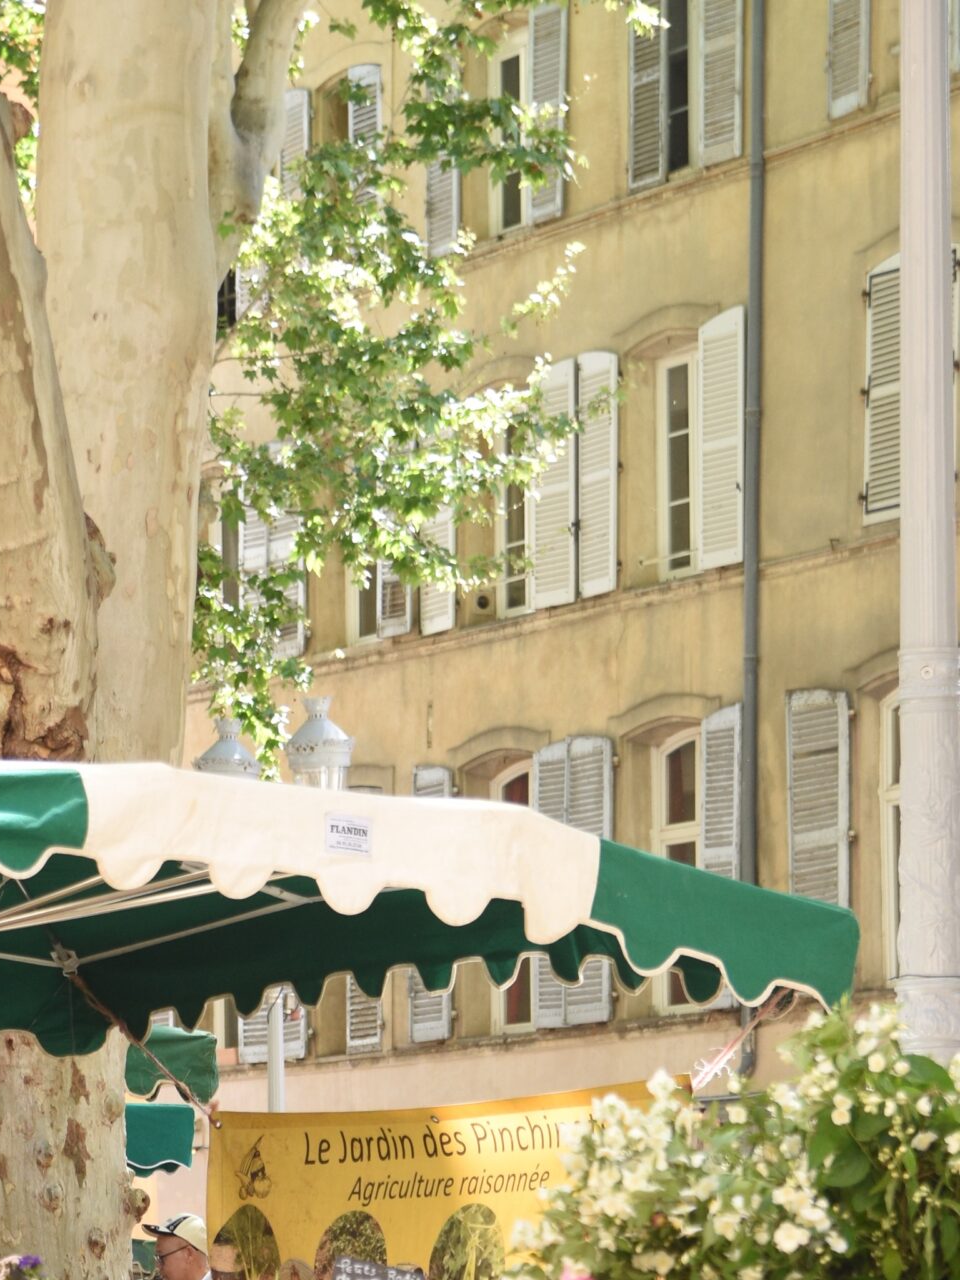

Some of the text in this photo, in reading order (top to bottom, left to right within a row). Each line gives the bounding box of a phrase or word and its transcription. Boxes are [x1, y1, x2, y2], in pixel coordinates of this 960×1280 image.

[304, 1131, 331, 1165] Le
[339, 1127, 415, 1164] Jardin
[422, 1124, 467, 1158] des
[347, 1163, 550, 1207] Agriculture raisonnée
